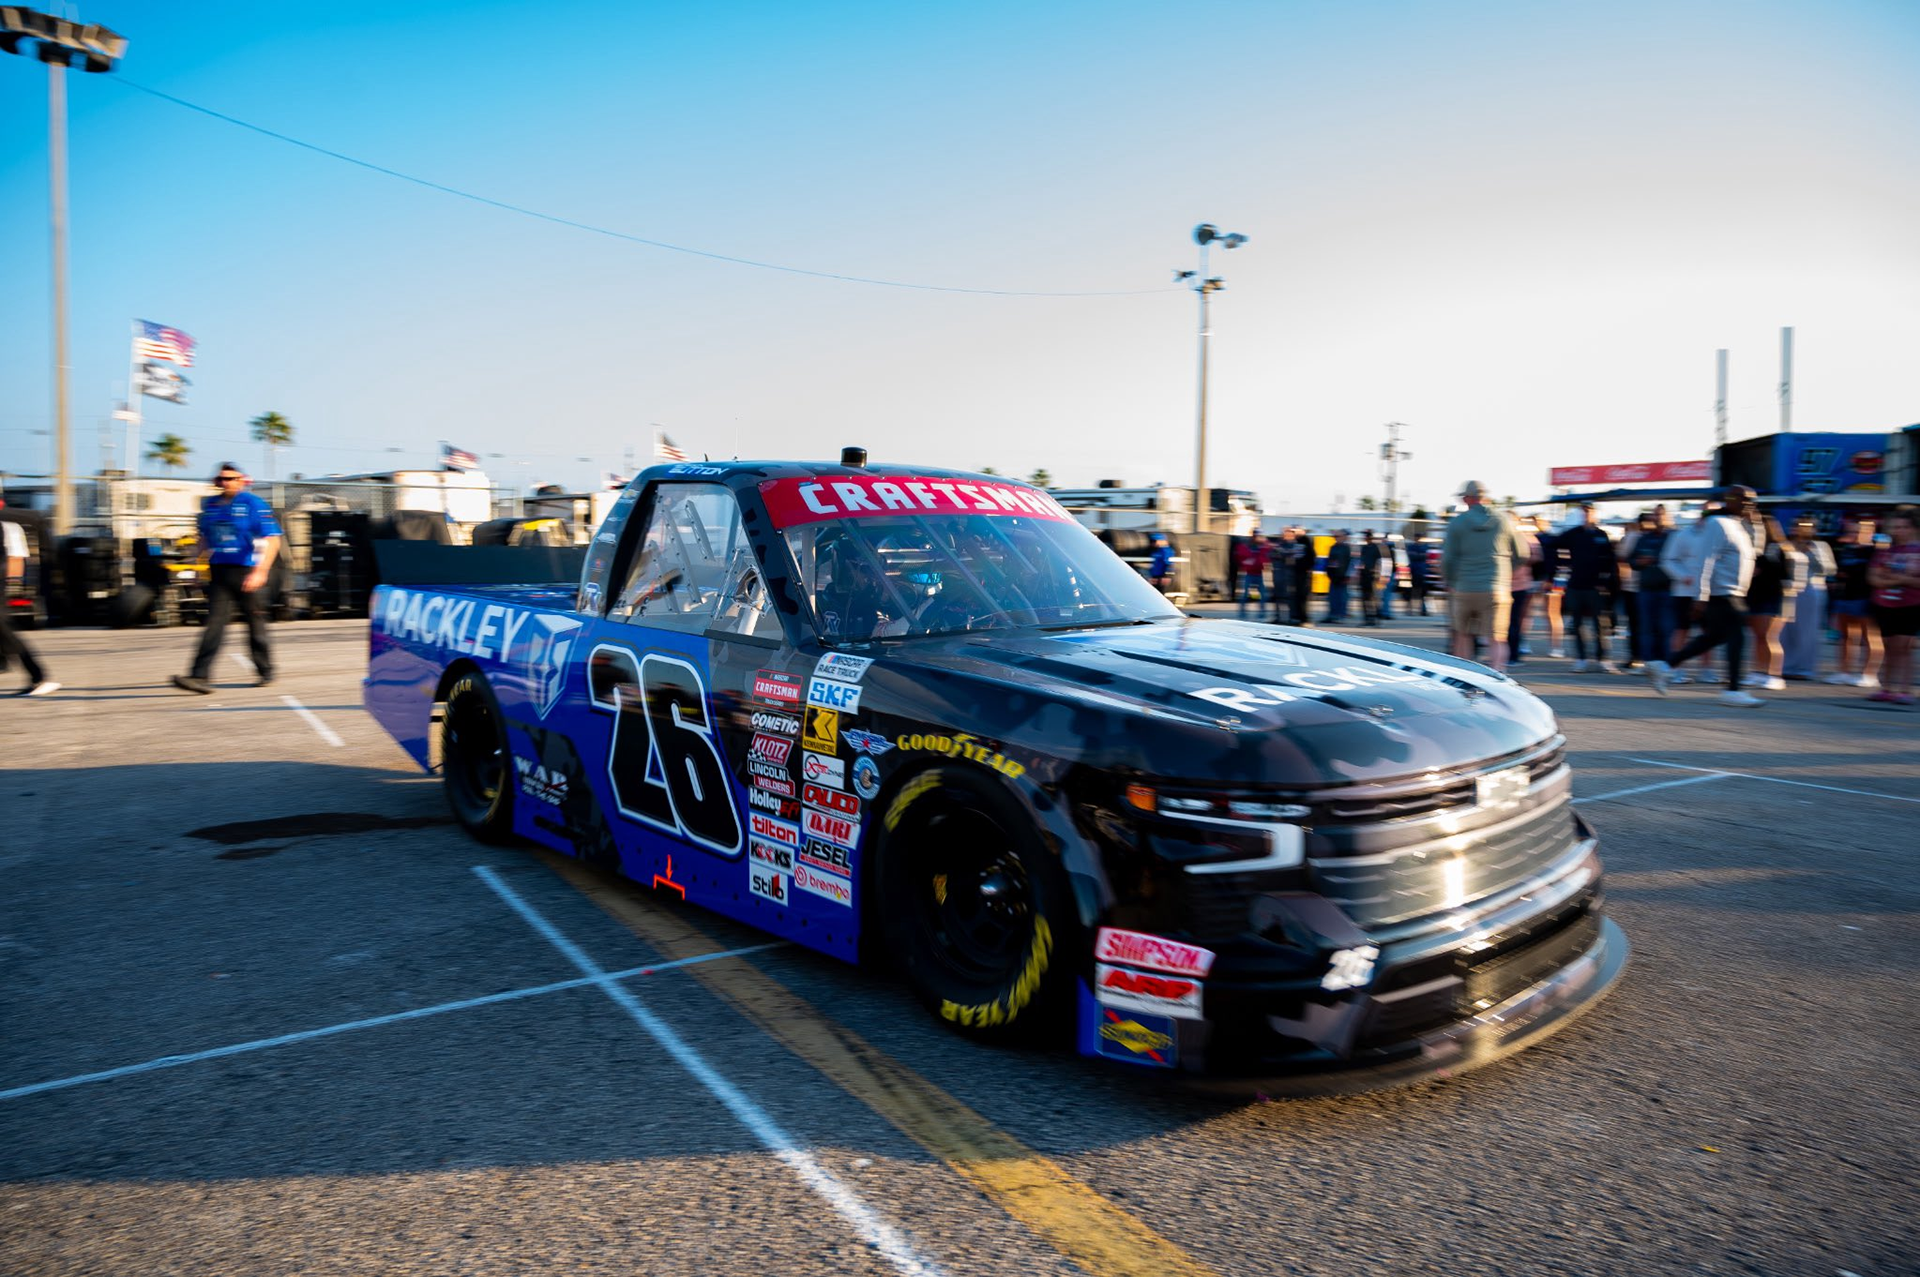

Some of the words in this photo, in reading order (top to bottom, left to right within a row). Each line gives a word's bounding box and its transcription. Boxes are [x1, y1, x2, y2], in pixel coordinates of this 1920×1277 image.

[798, 481, 1072, 518] CRAFTSMAN
[383, 589, 529, 662] RACKLEY
[817, 664, 837, 674] RACE
[837, 667, 860, 679] TRUCK
[755, 681, 799, 699] CRAFTSMAN
[809, 681, 858, 707] SKF
[751, 712, 799, 734] COMETIC
[588, 644, 742, 856] 26
[754, 737, 788, 759] KLOTZ
[750, 761, 786, 781] LINCOLN
[758, 777, 791, 794] WELDERS
[804, 784, 858, 815] CALICO
[749, 788, 781, 816] Holley
[752, 815, 797, 844] tilton
[750, 840, 792, 869] KOOKS
[801, 838, 851, 869] JESEL
[753, 873, 784, 900] Stilo
[809, 872, 849, 900] brembo
[1105, 933, 1203, 970] SIMPSON
[1105, 970, 1194, 999] ARP
